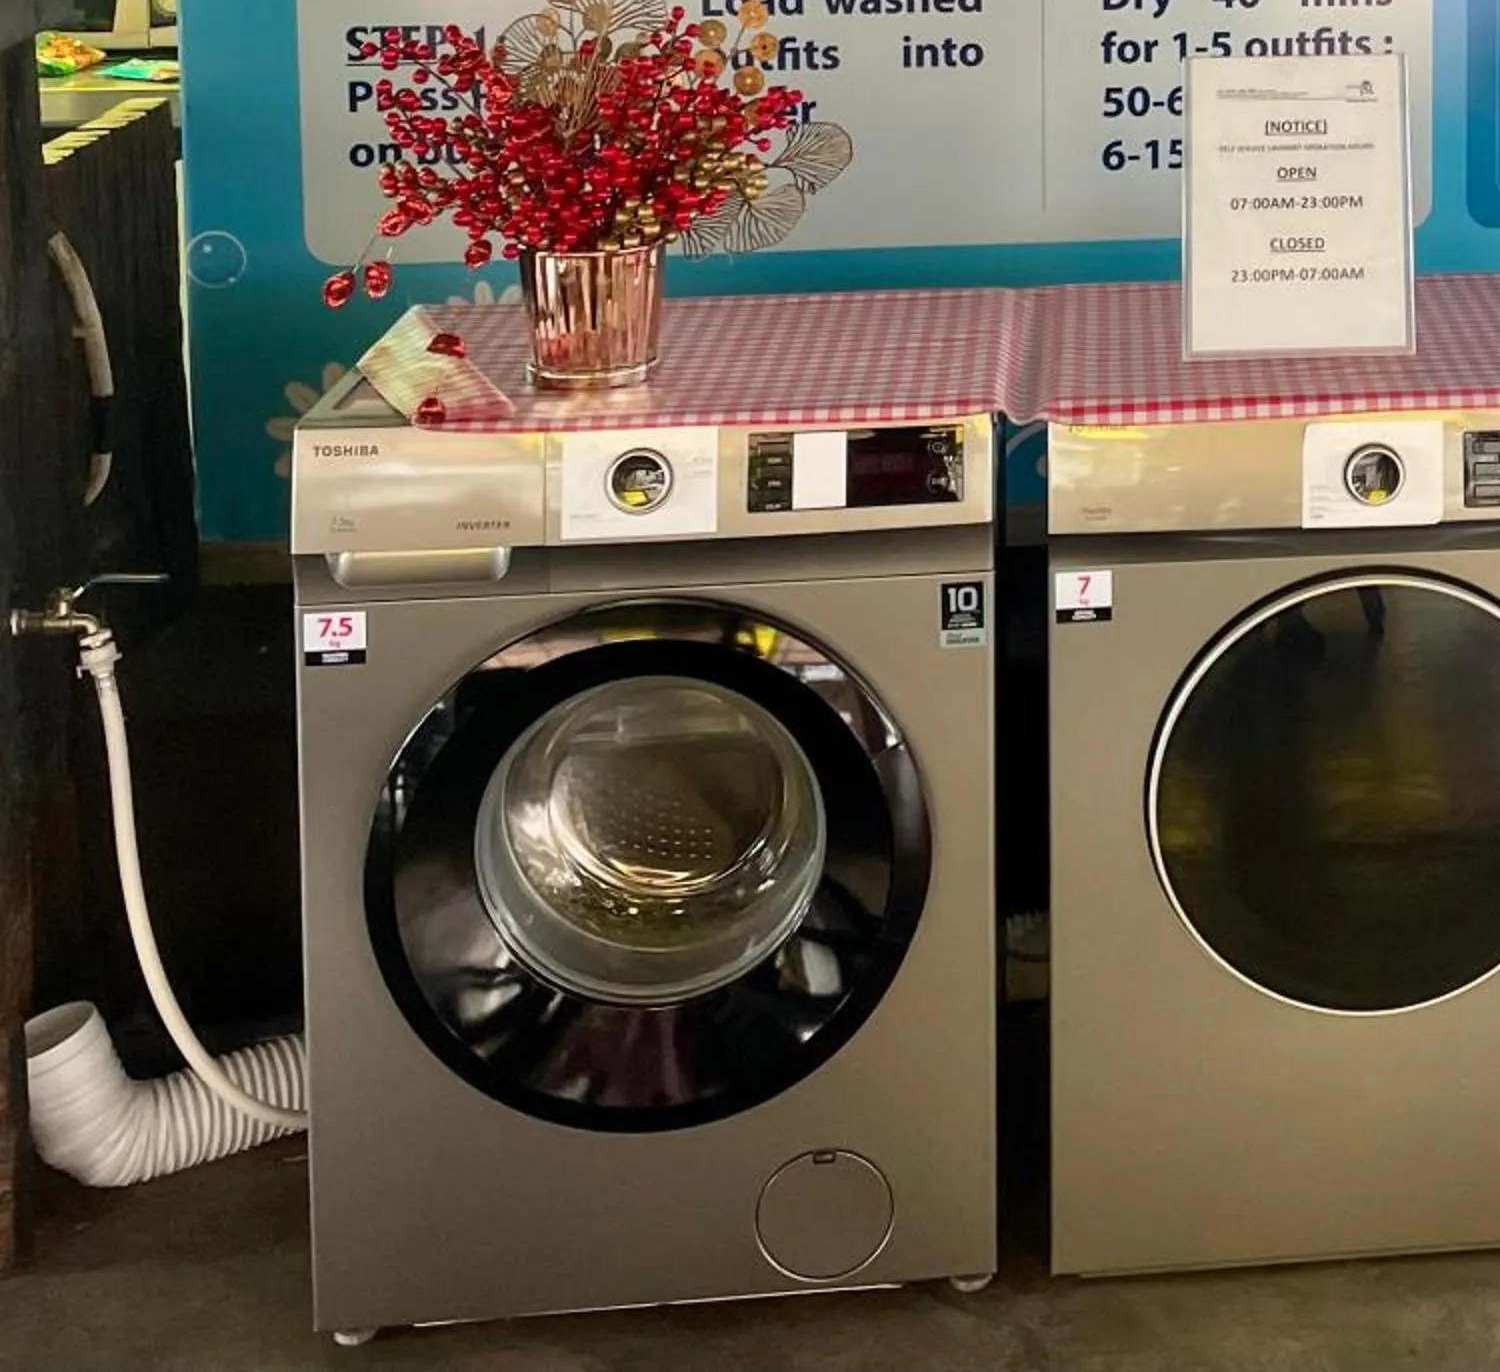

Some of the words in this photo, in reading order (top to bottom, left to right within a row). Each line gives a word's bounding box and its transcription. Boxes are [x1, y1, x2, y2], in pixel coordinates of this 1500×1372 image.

[902, 35, 984, 69] into
[1100, 30, 1159, 65] for
[1172, 31, 1232, 62] 1-5
[1277, 167, 1317, 178] OPEN
[1270, 237, 1325, 250] CLOSED
[314, 446, 379, 456] TOSHIBA
[1078, 576, 1091, 595] 7
[948, 587, 978, 612] 10
[318, 618, 353, 639] 7.5
